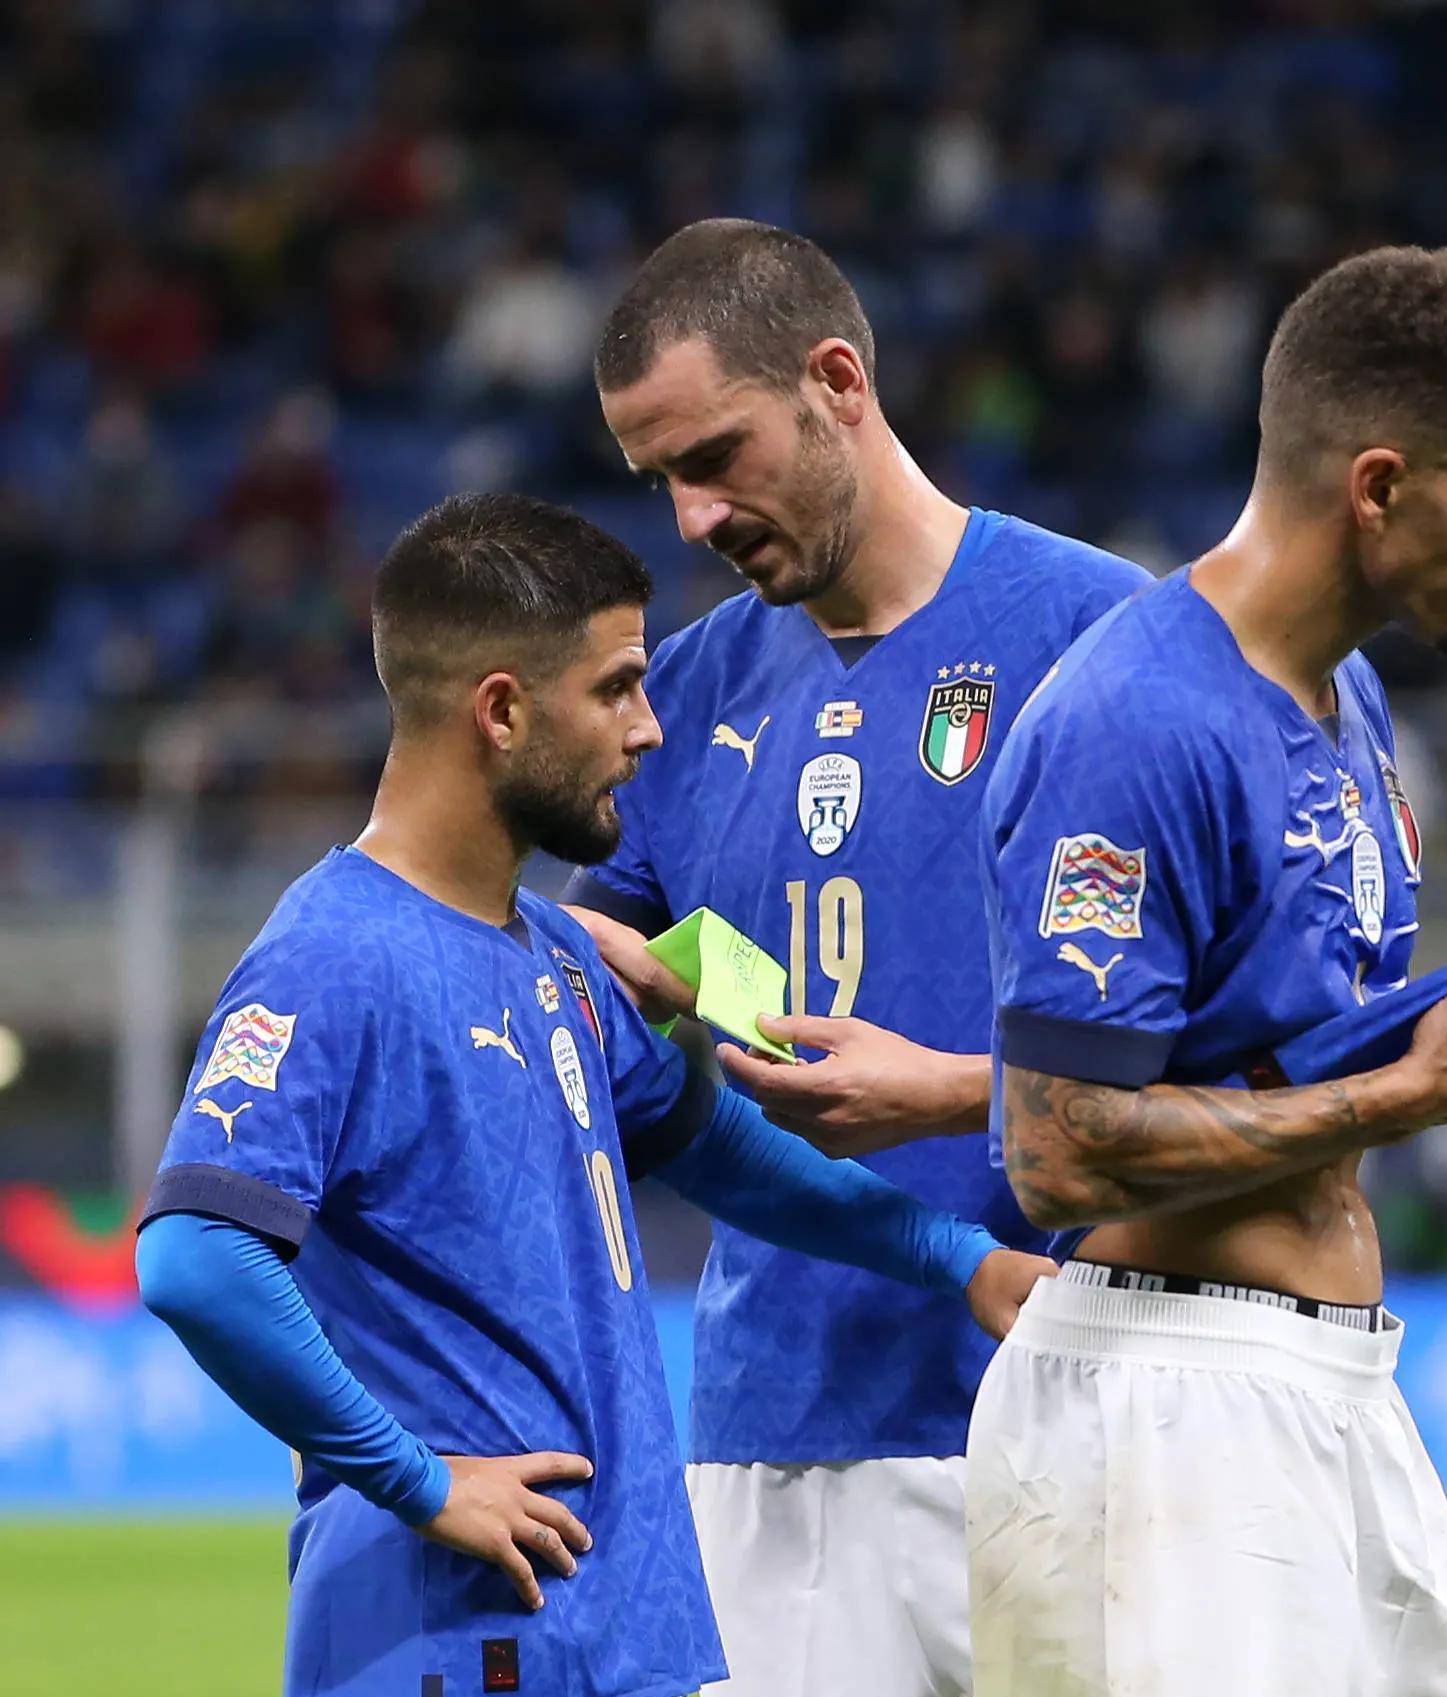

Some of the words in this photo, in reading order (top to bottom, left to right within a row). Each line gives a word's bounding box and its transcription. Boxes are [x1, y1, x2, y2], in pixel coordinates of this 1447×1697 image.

[935, 687, 989, 706] ITALIA
[808, 773, 851, 783] EUROPEAN
[808, 781, 851, 791] CHAMPIONS
[815, 835, 837, 846] 2020
[785, 876, 865, 1017] 19
[583, 1149, 632, 1292] 0
